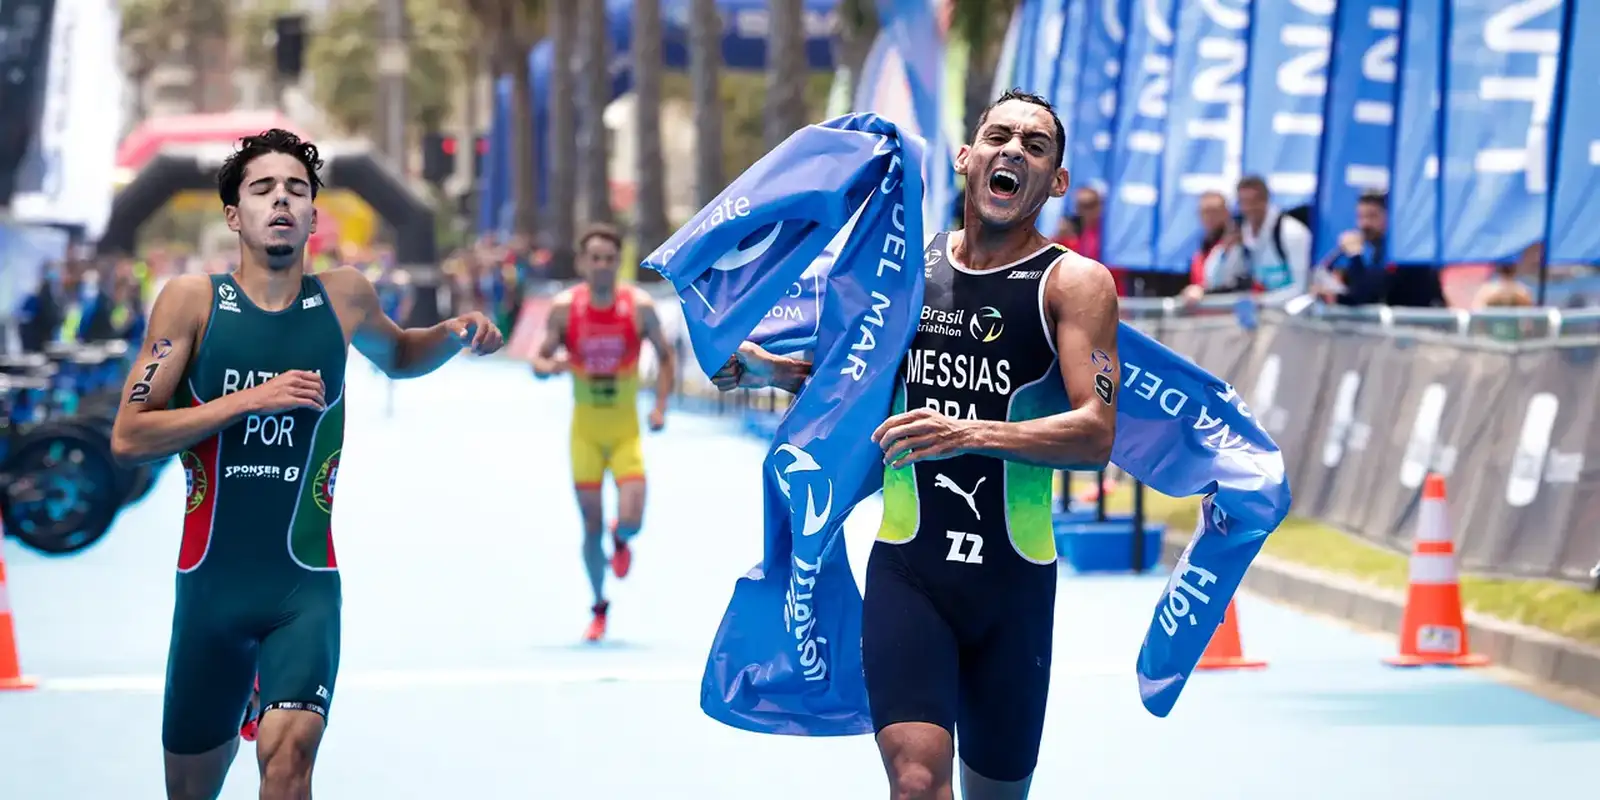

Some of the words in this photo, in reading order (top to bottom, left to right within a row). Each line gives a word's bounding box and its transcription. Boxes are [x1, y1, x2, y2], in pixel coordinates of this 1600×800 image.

[917, 322, 962, 337] triathlon
[920, 305, 965, 325] Brasil
[839, 289, 893, 384] MAR
[906, 348, 1011, 396] MESSIAS
[1123, 362, 1189, 417] DEL
[243, 414, 294, 447] POR
[225, 465, 281, 478] SPONSER
[945, 529, 984, 565] Z2
